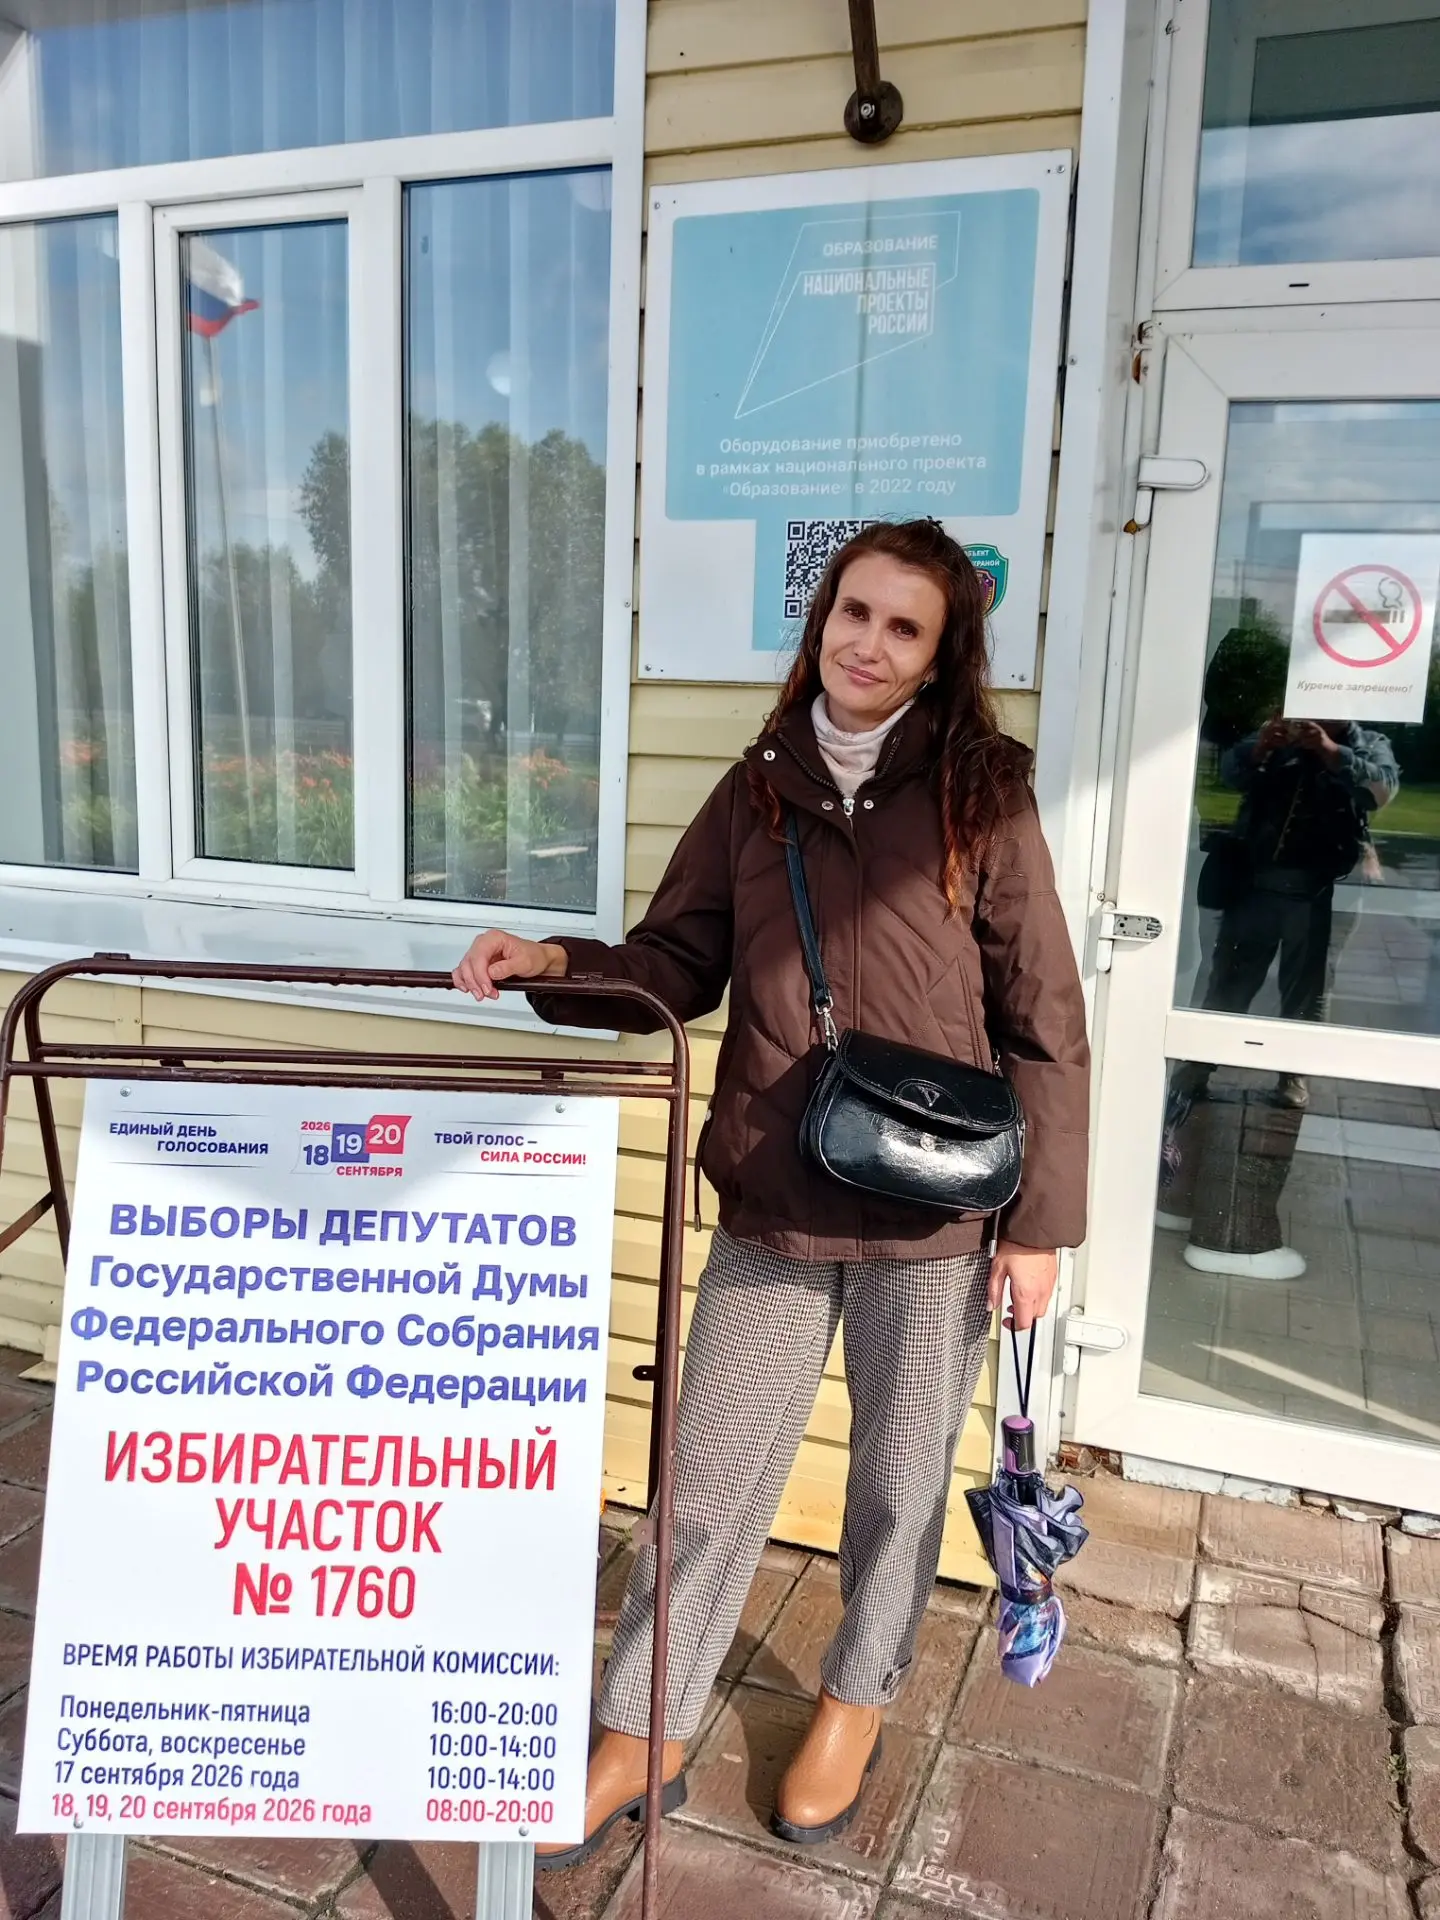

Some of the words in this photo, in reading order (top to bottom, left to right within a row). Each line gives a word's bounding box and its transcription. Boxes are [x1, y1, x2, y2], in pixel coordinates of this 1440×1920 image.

[822, 235, 938, 256] ОБРАЗОВАНИЕ
[803, 267, 930, 296] НАЦИОНАЛЬНЫЕ
[856, 290, 928, 314] ПРОЕКТЫ
[868, 312, 928, 334] РОССИИ
[720, 438, 842, 456] Оборудование
[846, 432, 962, 452] приобретено
[696, 464, 705, 476] в
[710, 462, 770, 478] рамках
[775, 458, 908, 476] национального
[913, 456, 987, 473] проекта
[854, 482, 864, 494] в
[870, 478, 912, 494] 2022
[917, 480, 956, 496] году
[1296, 680, 1343, 691] Курение
[1346, 684, 1413, 693] запрещено!
[109, 1122, 173, 1135] ЕДИНЫЙ
[176, 1124, 217, 1138] ДЕНЬ
[300, 1121, 331, 1131] 2026
[368, 1124, 401, 1145] 20
[156, 1140, 269, 1154] ГОЛОСОВАНИЯ
[336, 1134, 362, 1155] 19
[434, 1132, 473, 1145] ТВОЙ
[476, 1134, 524, 1146] ГОЛОС
[303, 1144, 329, 1166] 18
[480, 1151, 520, 1162] СИЛА
[524, 1152, 586, 1165] РОССИИ!
[336, 1166, 402, 1177] СЕНТЯБРЯ
[110, 1204, 308, 1240] ВЫБОРЫ
[319, 1210, 576, 1246] ДЕПУТАТОВ
[90, 1255, 462, 1299] Государственной
[472, 1264, 588, 1305] Думы
[70, 1306, 384, 1350] Федерального
[398, 1314, 600, 1356] Собрания
[76, 1360, 334, 1396] Российской
[346, 1364, 587, 1408] Федерации
[104, 1426, 558, 1490] ИЗБИРАТЕЛЬНЫЙ
[214, 1497, 443, 1553] УЧАСТОК
[232, 1562, 293, 1616] №
[310, 1565, 416, 1619] 1760
[62, 1643, 138, 1667] ВРЕМЯ
[146, 1645, 233, 1669] РАБОТЫ
[241, 1644, 424, 1672] ИЗБИРАТЕЛЬНОЙ
[432, 1650, 560, 1676] КОМИССИИ:
[60, 1694, 310, 1726] Понедельник-пятница
[431, 1701, 558, 1726] 16:00-20:00
[57, 1728, 153, 1756] Суббота,
[161, 1734, 306, 1759] воскресенье
[430, 1734, 556, 1758] 10:00-14:00
[55, 1760, 74, 1784] 17
[81, 1763, 184, 1791] сентября
[191, 1764, 243, 1787] 2026
[250, 1770, 300, 1792] года
[428, 1766, 555, 1791] 10:00-14:00
[52, 1793, 78, 1818] 18,
[87, 1794, 112, 1821] 19,
[120, 1794, 146, 1819] 20
[153, 1797, 256, 1825] сентября
[263, 1798, 315, 1822] 2026
[322, 1804, 371, 1826] года
[426, 1799, 554, 1824] 08:00-20:00
